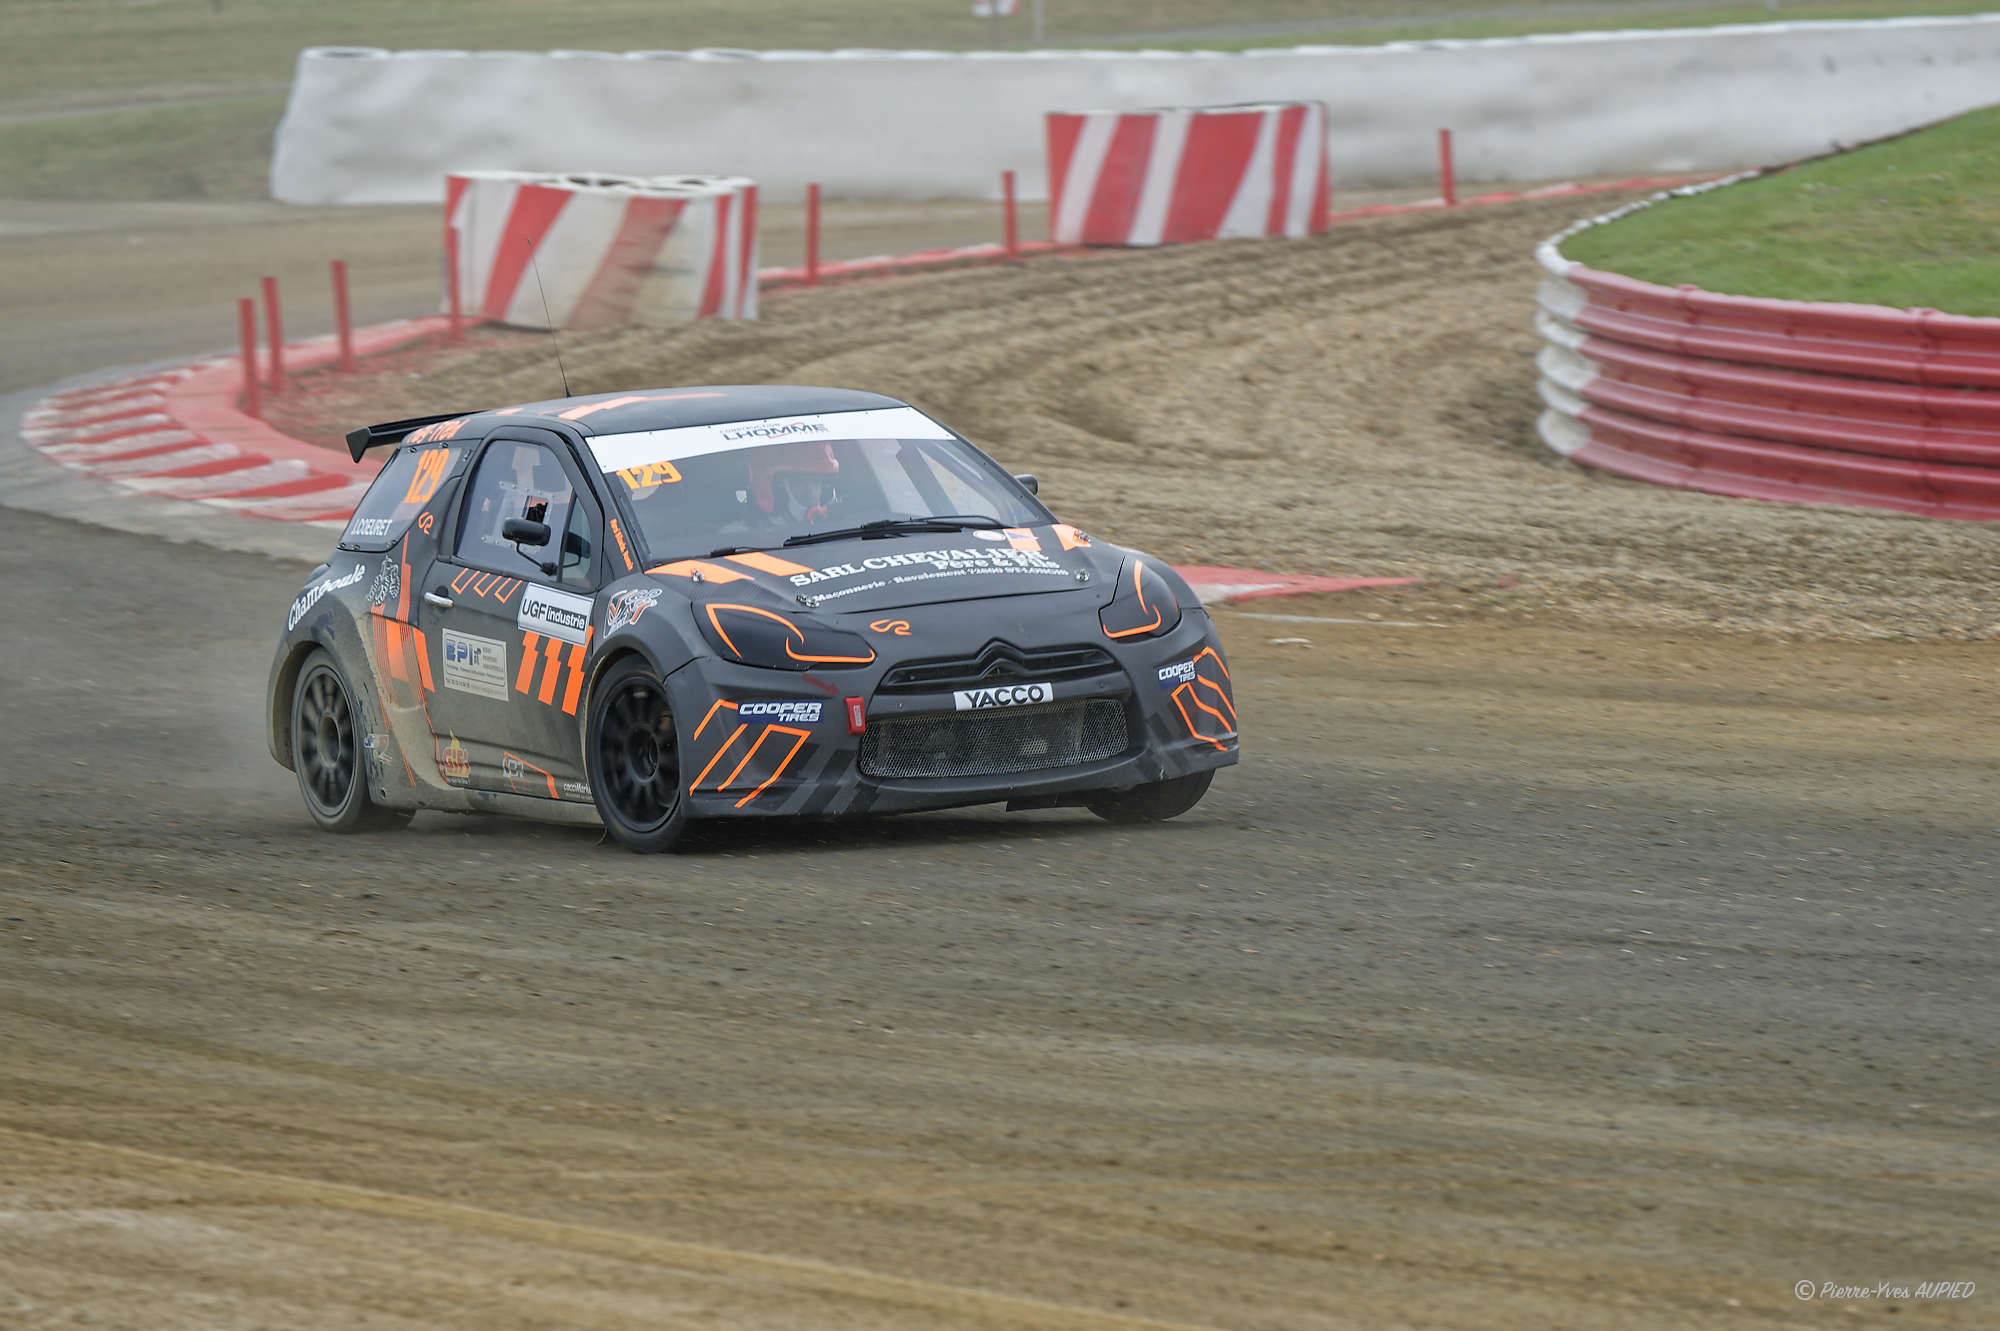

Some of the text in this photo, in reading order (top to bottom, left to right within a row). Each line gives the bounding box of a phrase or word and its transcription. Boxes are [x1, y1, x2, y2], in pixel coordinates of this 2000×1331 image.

[723, 422, 829, 440] LHOMME
[404, 448, 450, 504] 129
[616, 461, 682, 490] 129
[789, 548, 1049, 587] SARL CHEVALIER
[892, 569, 966, 584] Ravalement
[521, 598, 547, 621] UGF
[547, 606, 586, 630] industrie
[1158, 660, 1195, 681] COOPER
[964, 685, 1045, 709] YACCO
[739, 702, 822, 715] COOPER
[777, 712, 821, 722] TIRES
